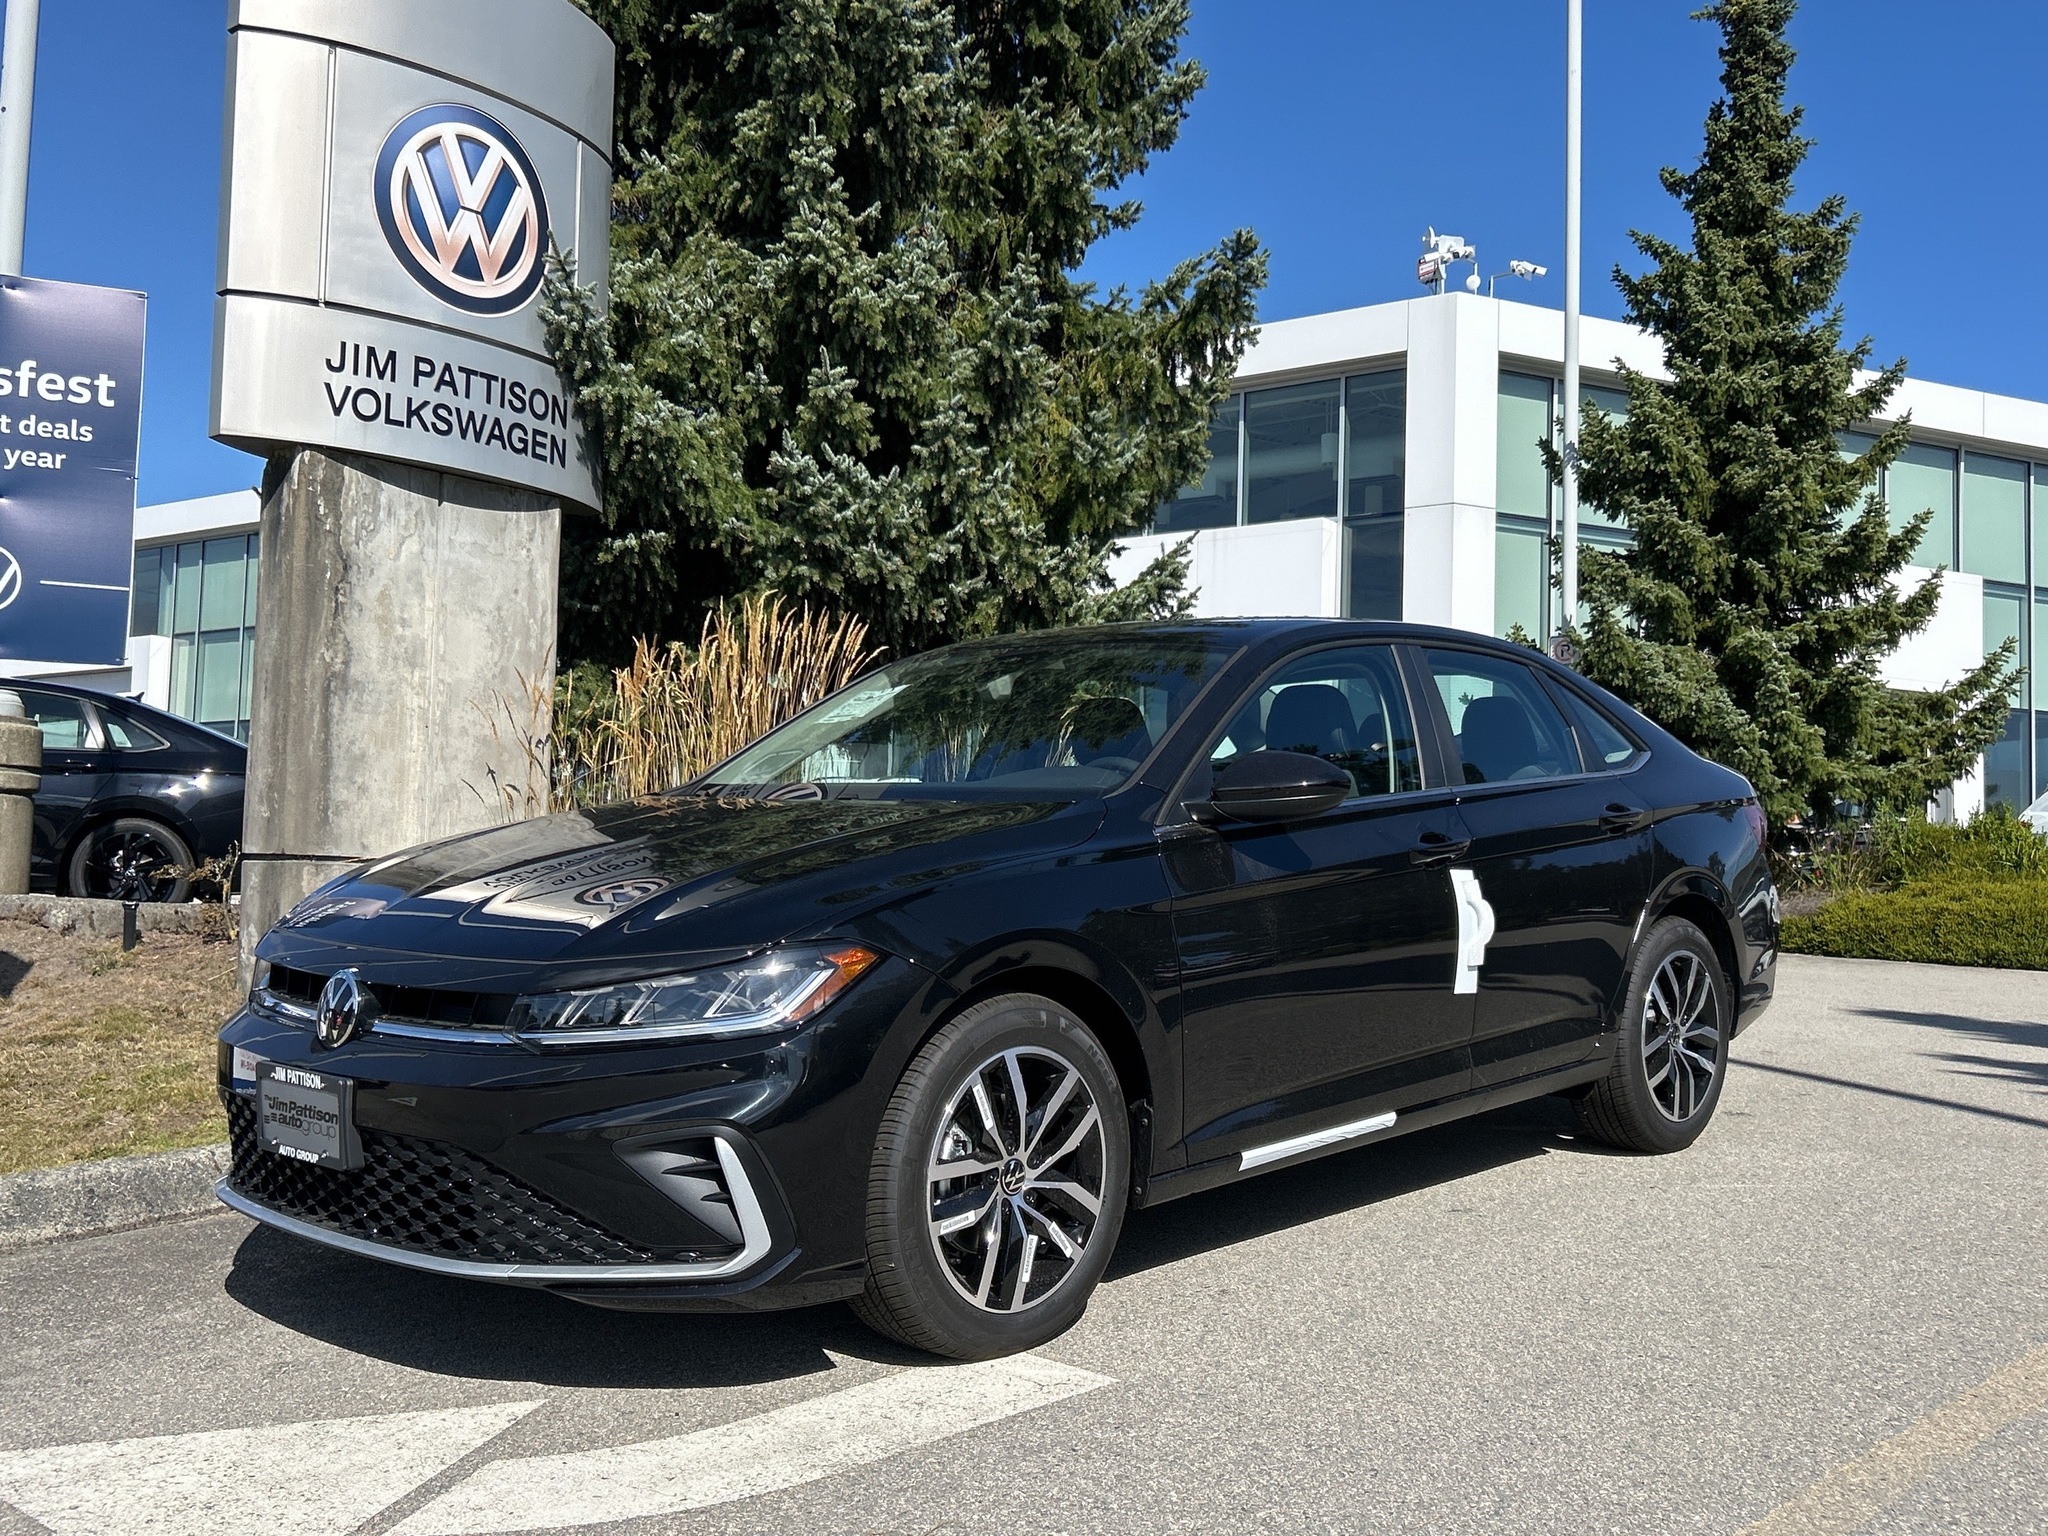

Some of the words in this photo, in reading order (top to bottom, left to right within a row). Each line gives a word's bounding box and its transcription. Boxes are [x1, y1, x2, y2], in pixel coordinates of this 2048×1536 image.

[325, 340, 398, 383] JIM
[413, 354, 568, 430] PATTISON
[18, 414, 93, 442] deals
[323, 381, 567, 470] VOLKSWAGEN
[3, 448, 67, 470] year
[275, 1066, 287, 1082] JIM
[287, 1069, 321, 1090] PATTISON
[278, 1144, 296, 1158] AUTO
[296, 1149, 320, 1164] GROUP
